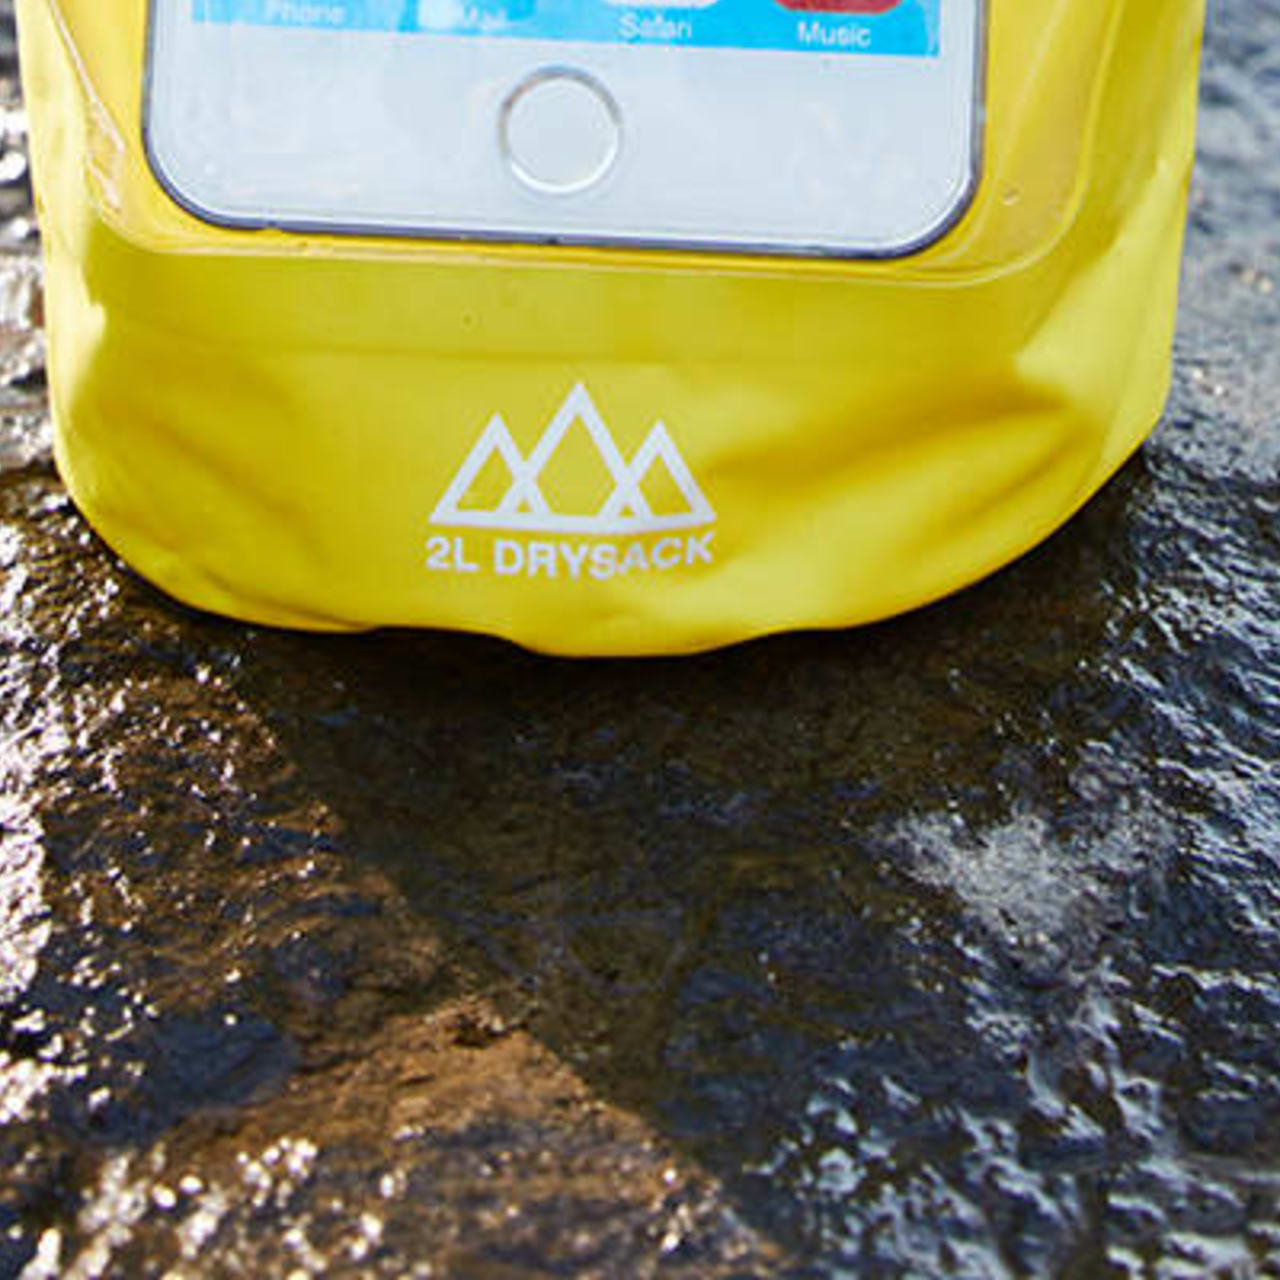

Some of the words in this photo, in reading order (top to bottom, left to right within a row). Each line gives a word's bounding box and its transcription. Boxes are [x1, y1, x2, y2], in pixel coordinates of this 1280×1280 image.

[265, 0, 347, 25] Phone
[620, 14, 693, 40] Safari
[797, 21, 871, 47] Music
[425, 536, 480, 572] 2L
[494, 531, 716, 580] DRYSACK
